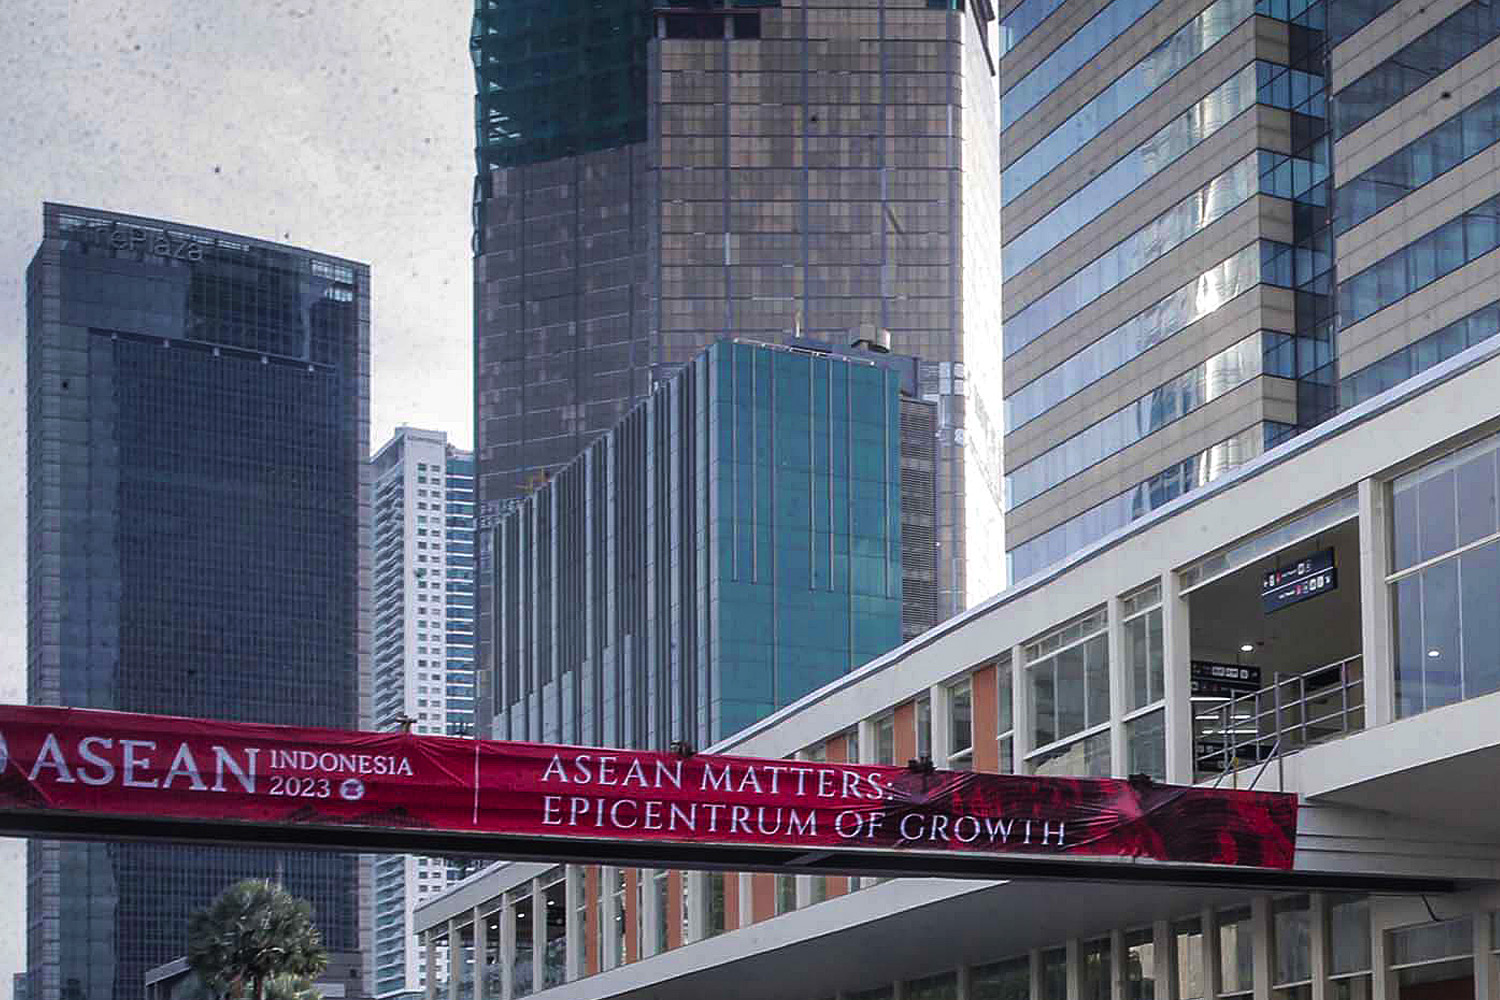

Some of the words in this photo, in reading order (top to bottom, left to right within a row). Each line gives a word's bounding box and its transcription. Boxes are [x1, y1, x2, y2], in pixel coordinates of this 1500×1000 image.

[28, 733, 259, 794] ASEAN
[269, 776, 331, 798] 2023
[270, 749, 413, 777] INDONESIA
[541, 753, 683, 790] ASEAN
[699, 763, 894, 801] MATTERS:
[541, 795, 818, 837] EPICENTRUM
[834, 809, 886, 839] OF
[901, 812, 1066, 846] GROWTH
